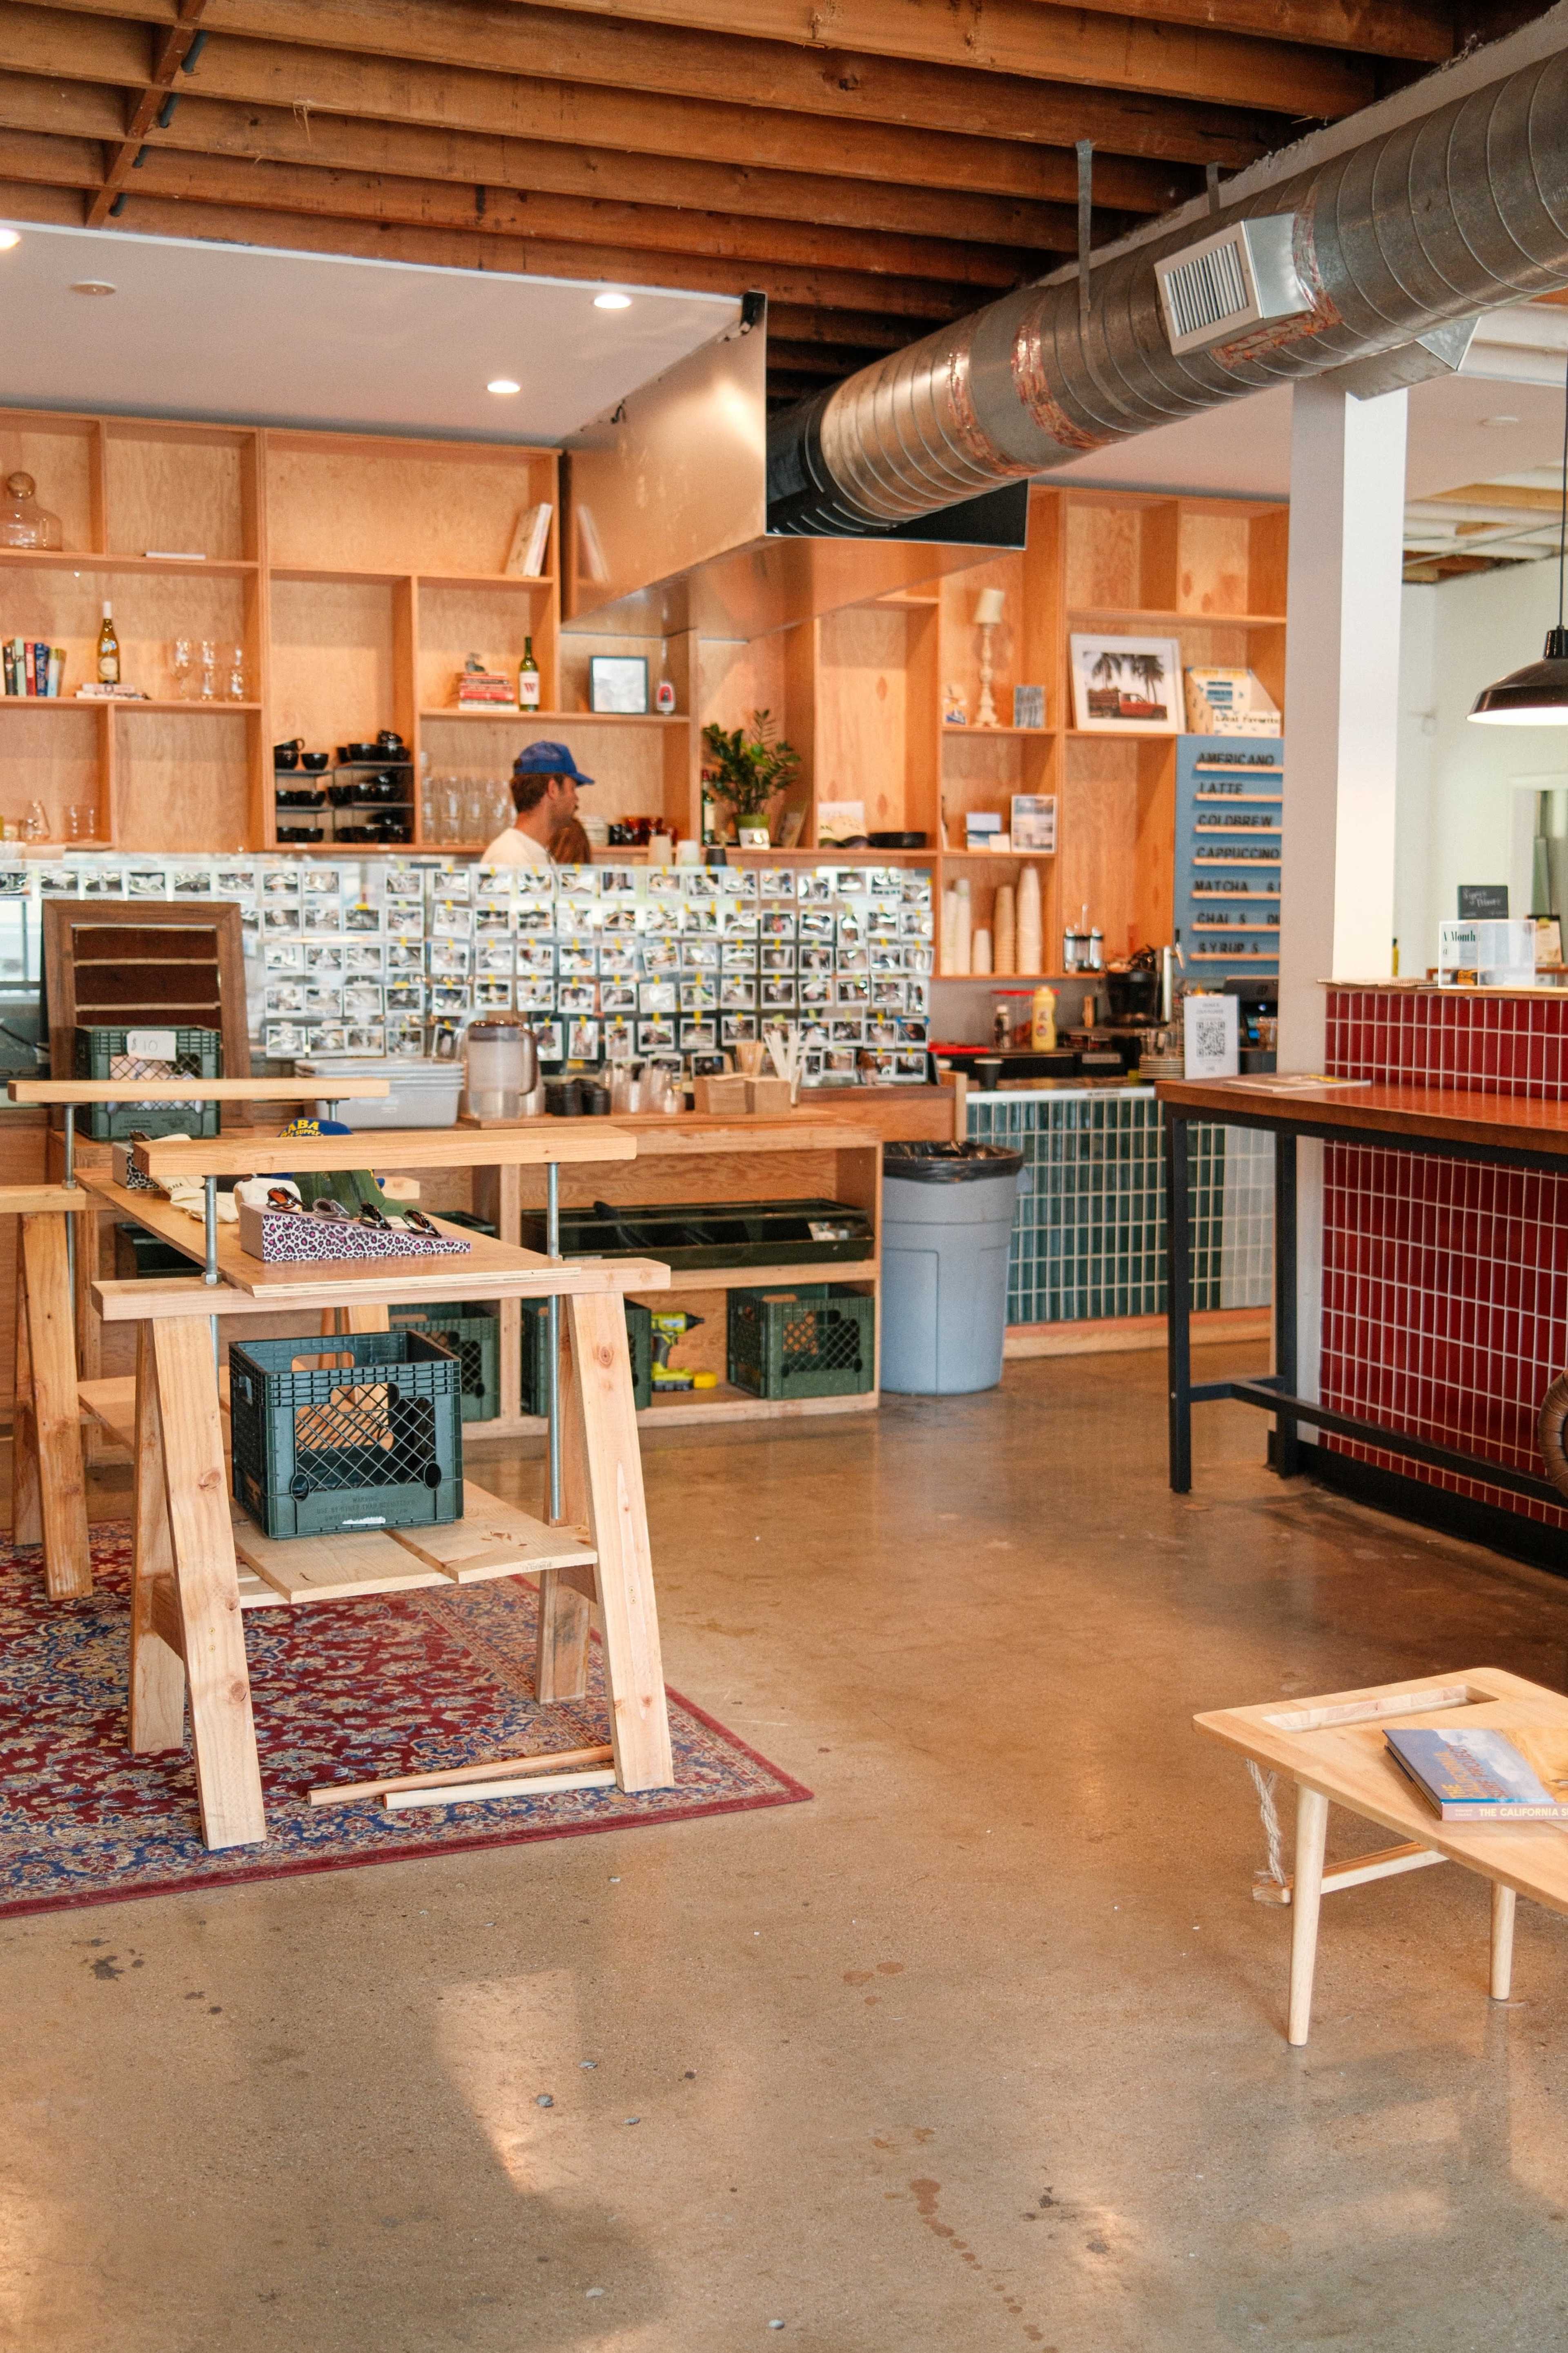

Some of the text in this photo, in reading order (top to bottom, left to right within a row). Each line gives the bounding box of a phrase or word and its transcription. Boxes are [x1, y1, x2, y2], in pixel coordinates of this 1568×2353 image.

[1197, 753, 1274, 765] AMERICANO
[1200, 782, 1243, 794] LATTE
[1197, 847, 1280, 859] CAPPUCCINO
[1195, 881, 1248, 892] MATCHA
[1197, 913, 1228, 923] CHAI
[1450, 930, 1476, 942] Month
[1445, 1743, 1491, 1777] PROJECT
[1440, 1784, 1469, 1798] THE
[1479, 1808, 1497, 1817] THE
[1500, 1808, 1559, 1817] CALIFORNIA
[1561, 1808, 1568, 1817] S
